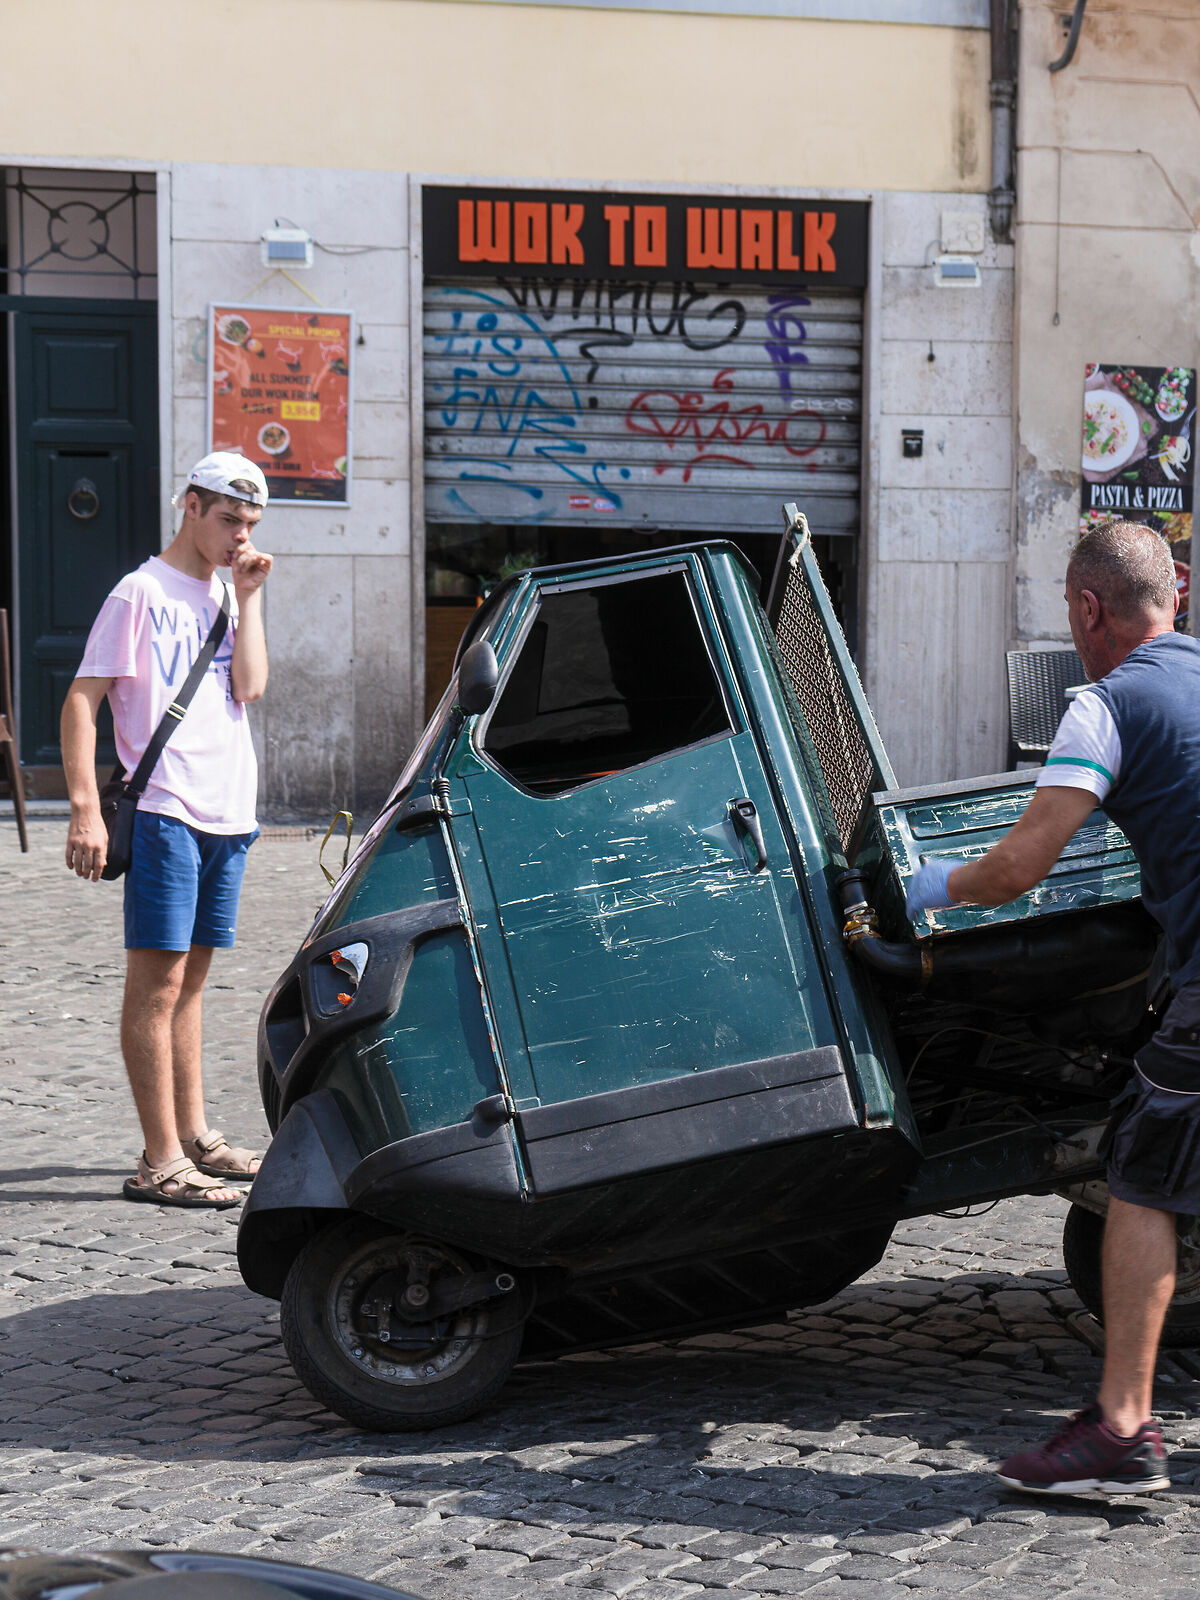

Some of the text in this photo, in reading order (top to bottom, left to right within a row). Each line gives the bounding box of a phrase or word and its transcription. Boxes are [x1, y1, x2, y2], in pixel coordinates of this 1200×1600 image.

[457, 199, 837, 273] WOK TO WALK
[268, 325, 341, 338] SPECIAL PROMO
[250, 373, 312, 385] ALL SUMMER
[241, 388, 319, 401] OUR WOK FROM
[1090, 484, 1183, 510] PASTA & PIZZA
